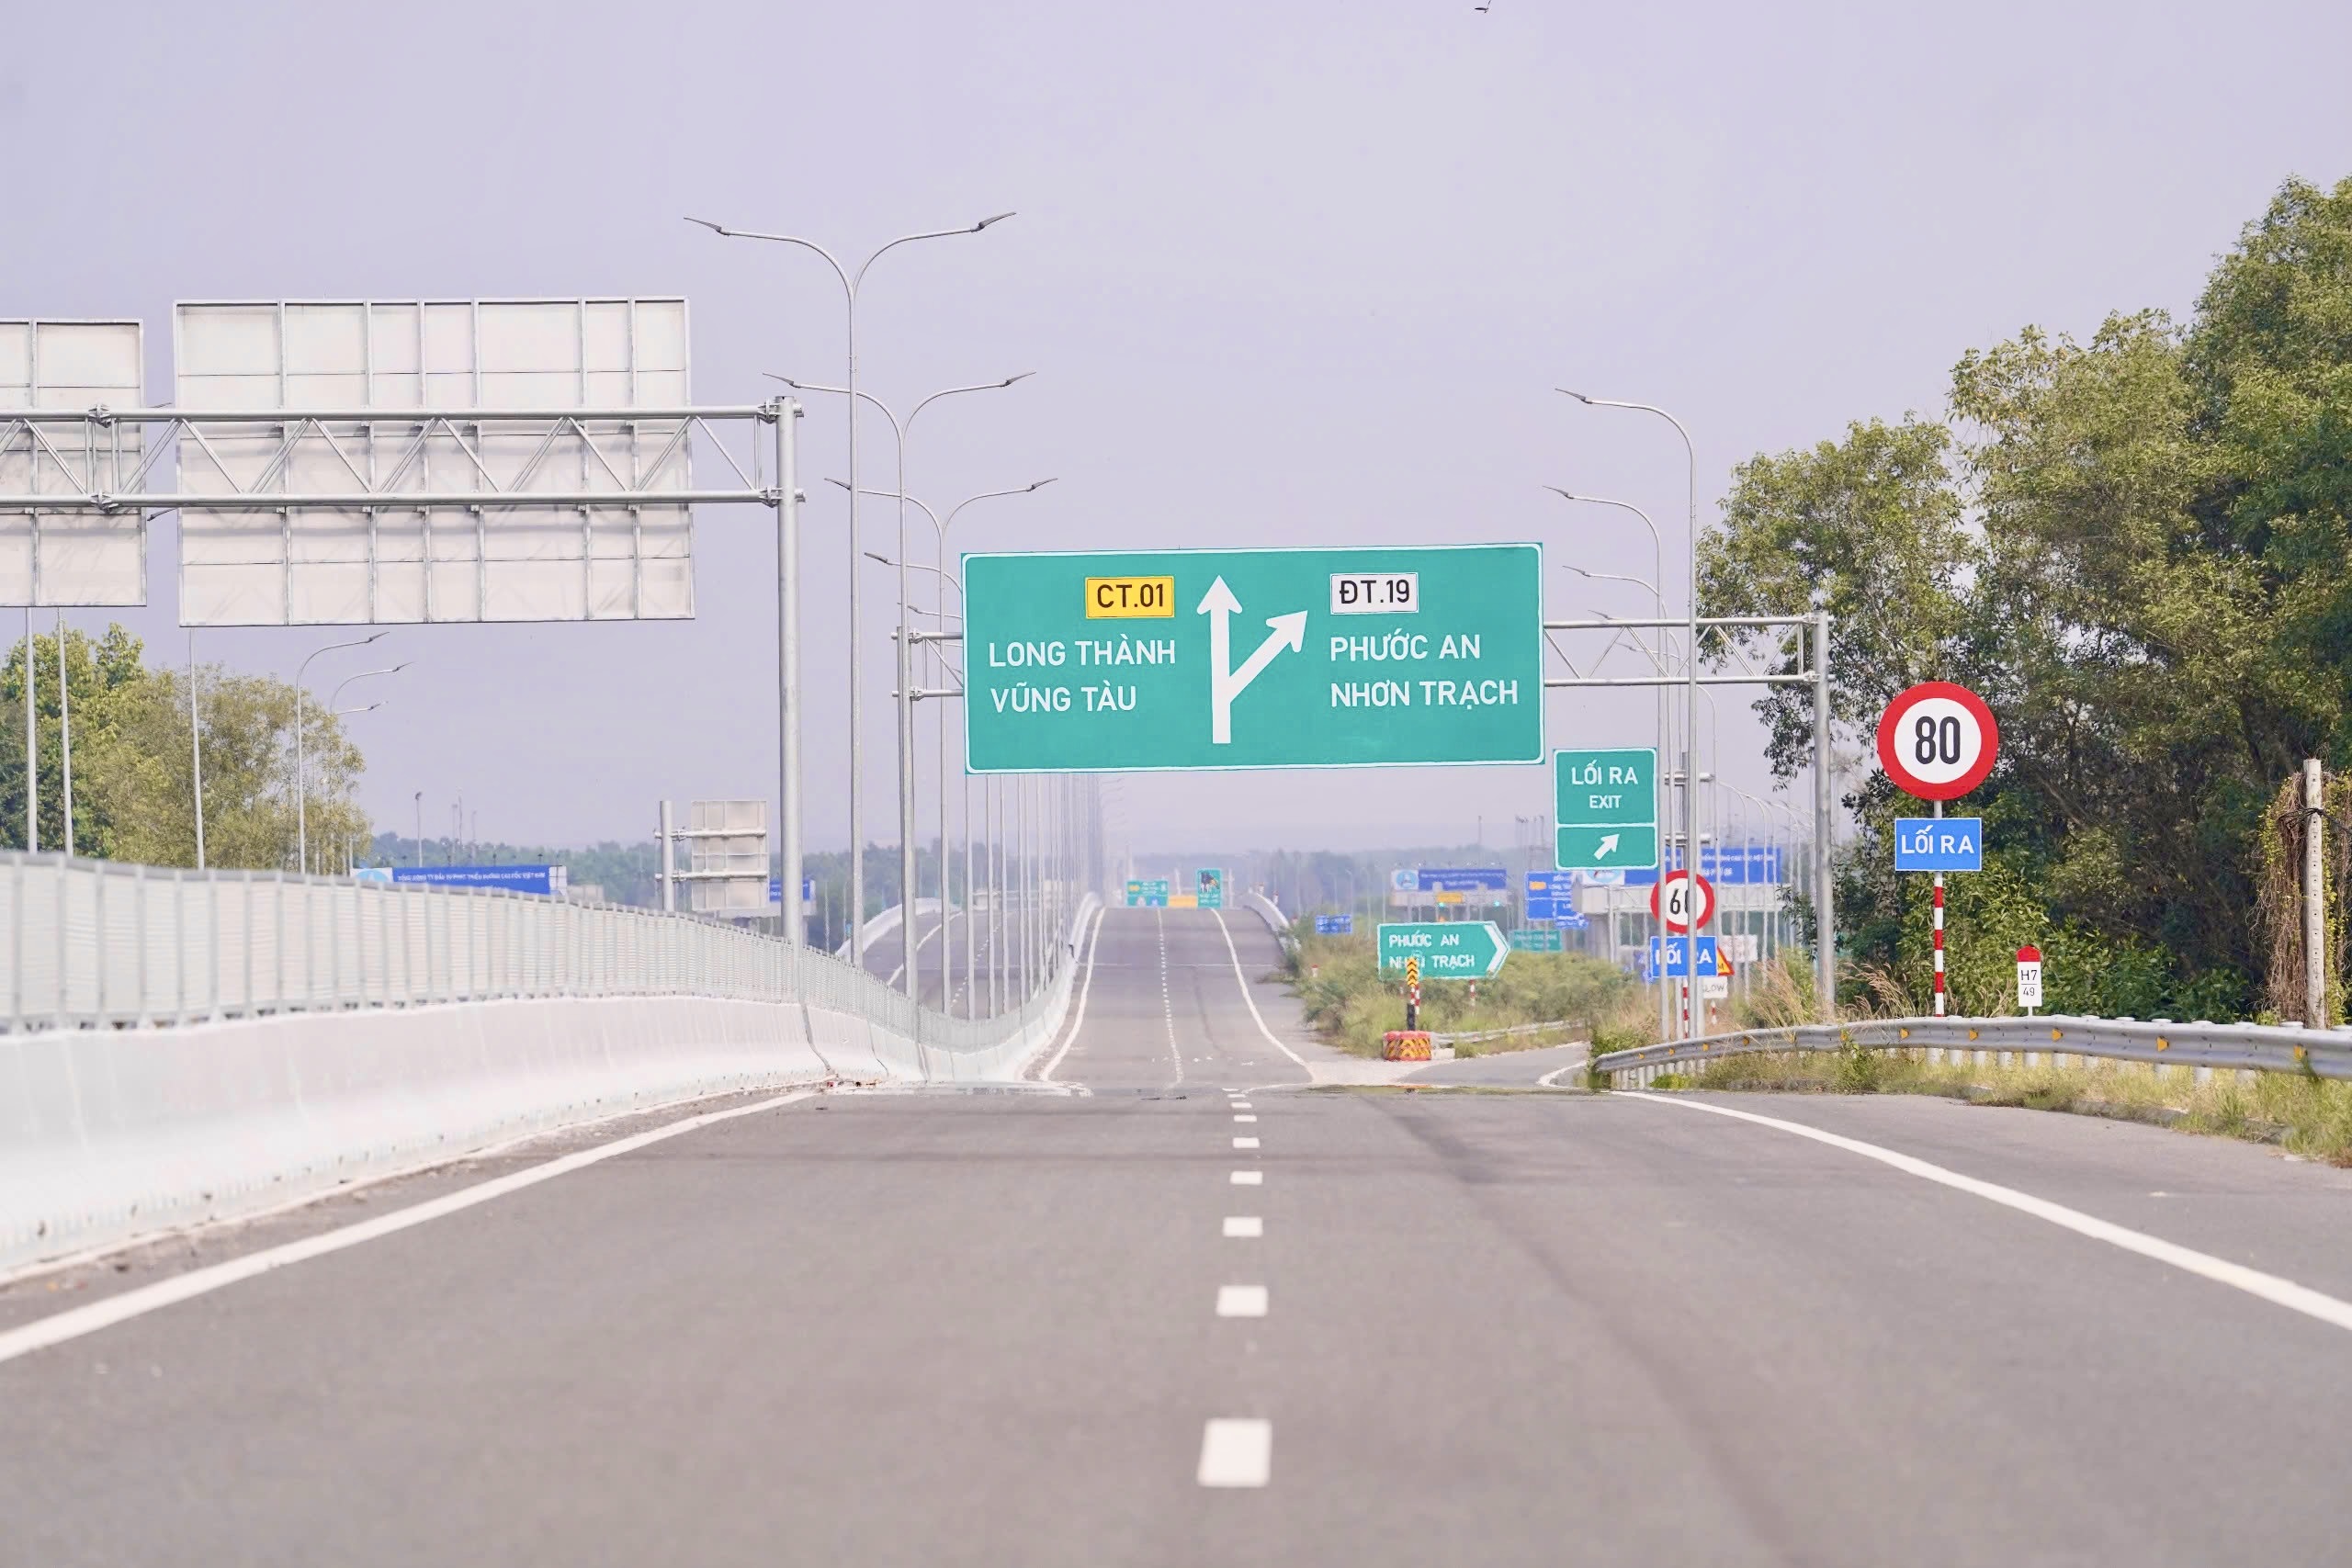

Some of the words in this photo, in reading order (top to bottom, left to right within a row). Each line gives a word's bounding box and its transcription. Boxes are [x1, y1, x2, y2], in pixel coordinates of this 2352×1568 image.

[1097, 583, 1164, 608] CT.01
[1339, 579, 1410, 604] ĐT.19
[989, 641, 1066, 667] LONG
[1074, 633, 1176, 666] THÀNH
[1330, 627, 1429, 661] PHƯỚC
[1438, 634, 1480, 660] AN
[990, 682, 1071, 713] VŨNG
[1080, 680, 1136, 712] TÀU
[1330, 679, 1410, 707] NHƠN
[1419, 680, 1518, 710] TRẠCH
[1915, 716, 1961, 764] 80
[1571, 759, 1602, 785] LỐI
[1609, 766, 1639, 785] RA
[1589, 795, 1623, 808] EXIT
[1901, 825, 1934, 854] LỐI
[1940, 835, 1974, 854] RA
[1440, 933, 1459, 947] AN
[1430, 954, 1475, 970] TRẠCH
[2020, 969, 2038, 981] H7
[2023, 987, 2035, 997] 49
